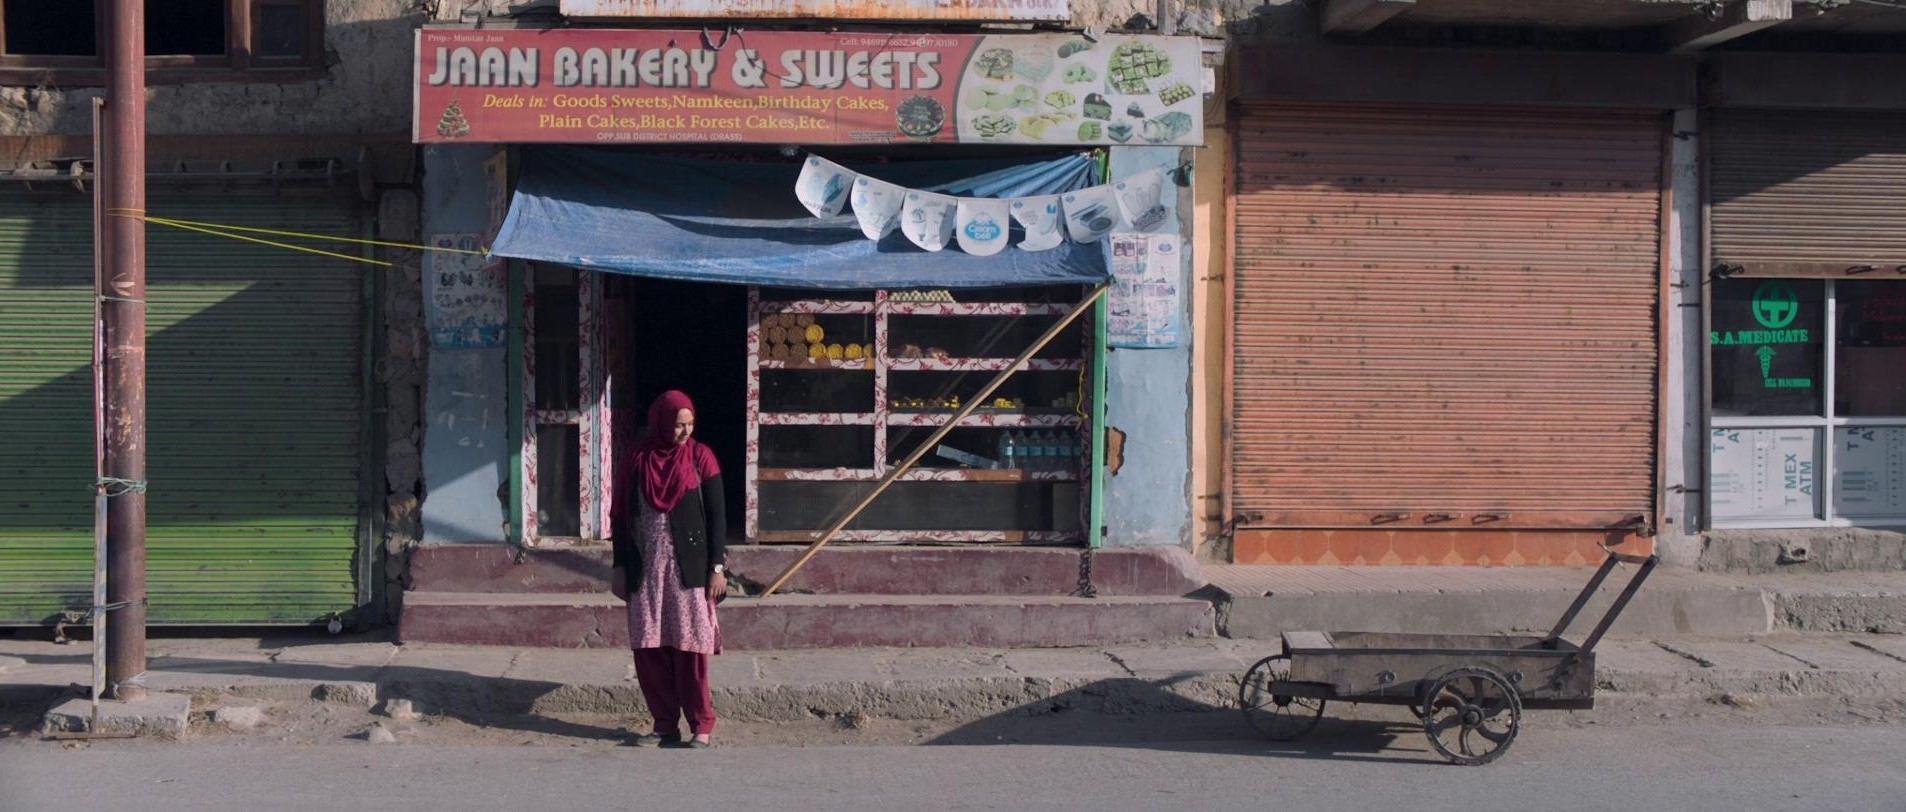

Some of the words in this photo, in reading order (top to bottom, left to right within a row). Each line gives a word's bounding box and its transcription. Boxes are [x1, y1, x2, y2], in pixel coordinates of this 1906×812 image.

[428, 46, 540, 87] JAAN
[553, 47, 716, 88] BAKERY
[731, 48, 766, 88] &
[780, 49, 942, 90] SWEETS
[483, 94, 524, 108] Deals
[529, 95, 547, 108] in:
[553, 94, 608, 108] Goods
[836, 96, 889, 111] Cakes,
[539, 114, 582, 128] Plain
[587, 114, 686, 130] Cakes,Black
[691, 115, 740, 129] Forest
[633, 133, 668, 141] DISTRICT
[669, 133, 708, 141] HOSPITAL
[1710, 329, 1809, 345] S.A.MEDICATE
[1785, 453, 1797, 489] MEX
[1800, 460, 1812, 496] ATM
